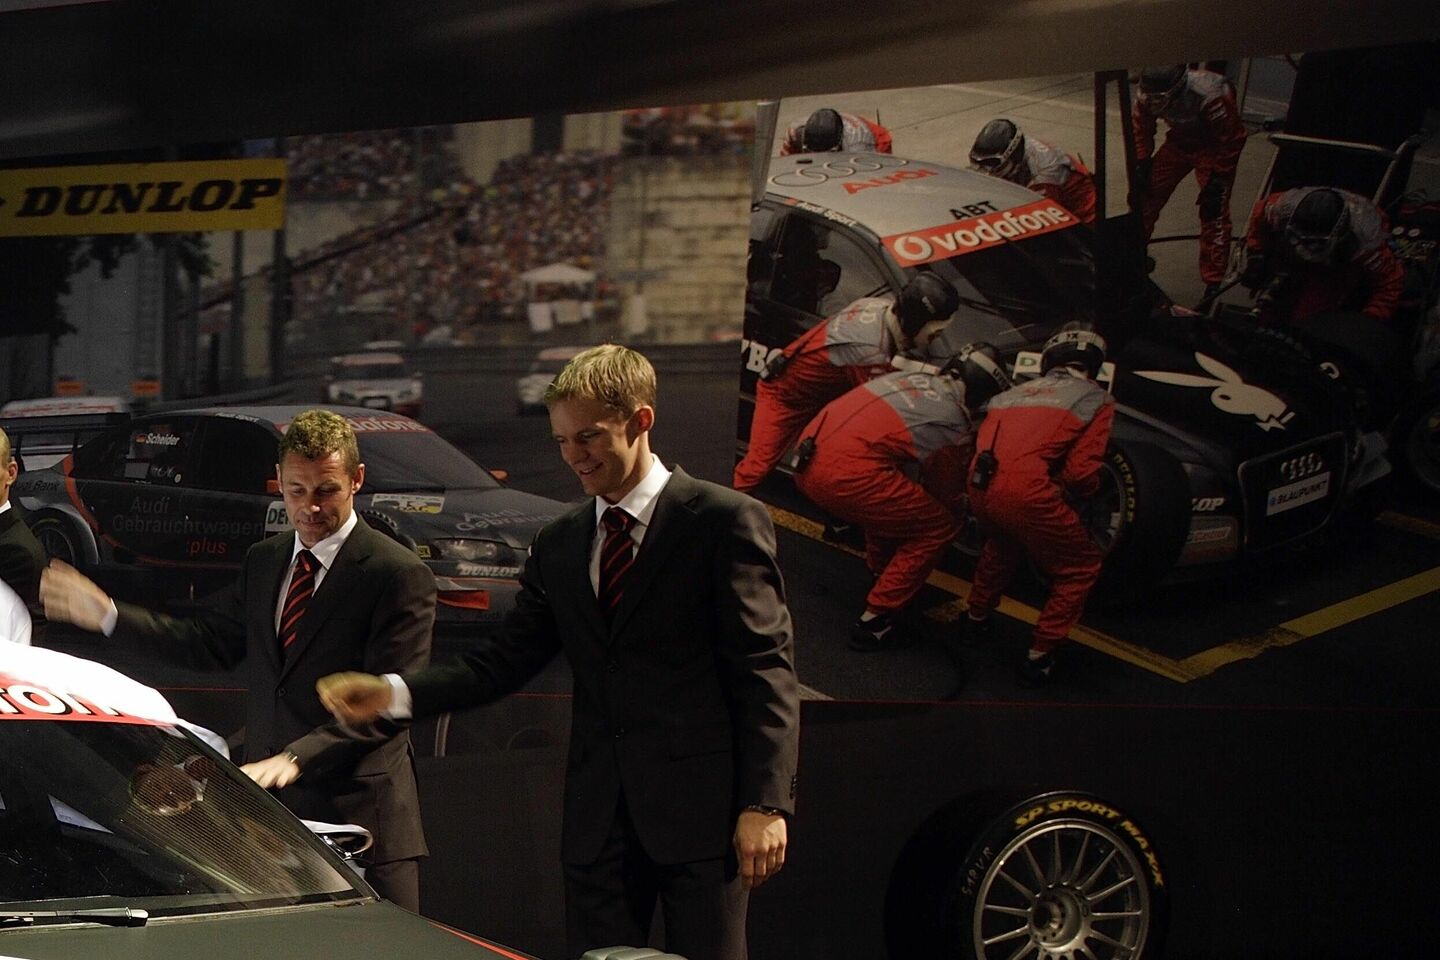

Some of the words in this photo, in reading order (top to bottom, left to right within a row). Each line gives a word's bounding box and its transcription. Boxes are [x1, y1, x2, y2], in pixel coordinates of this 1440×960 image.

[843, 169, 939, 194] Audi
[15, 179, 283, 217] DUNLOP
[948, 201, 999, 220] ABT
[931, 203, 1071, 252] vodafone
[129, 496, 169, 513] Audi
[1047, 798, 1121, 820] SPORT
